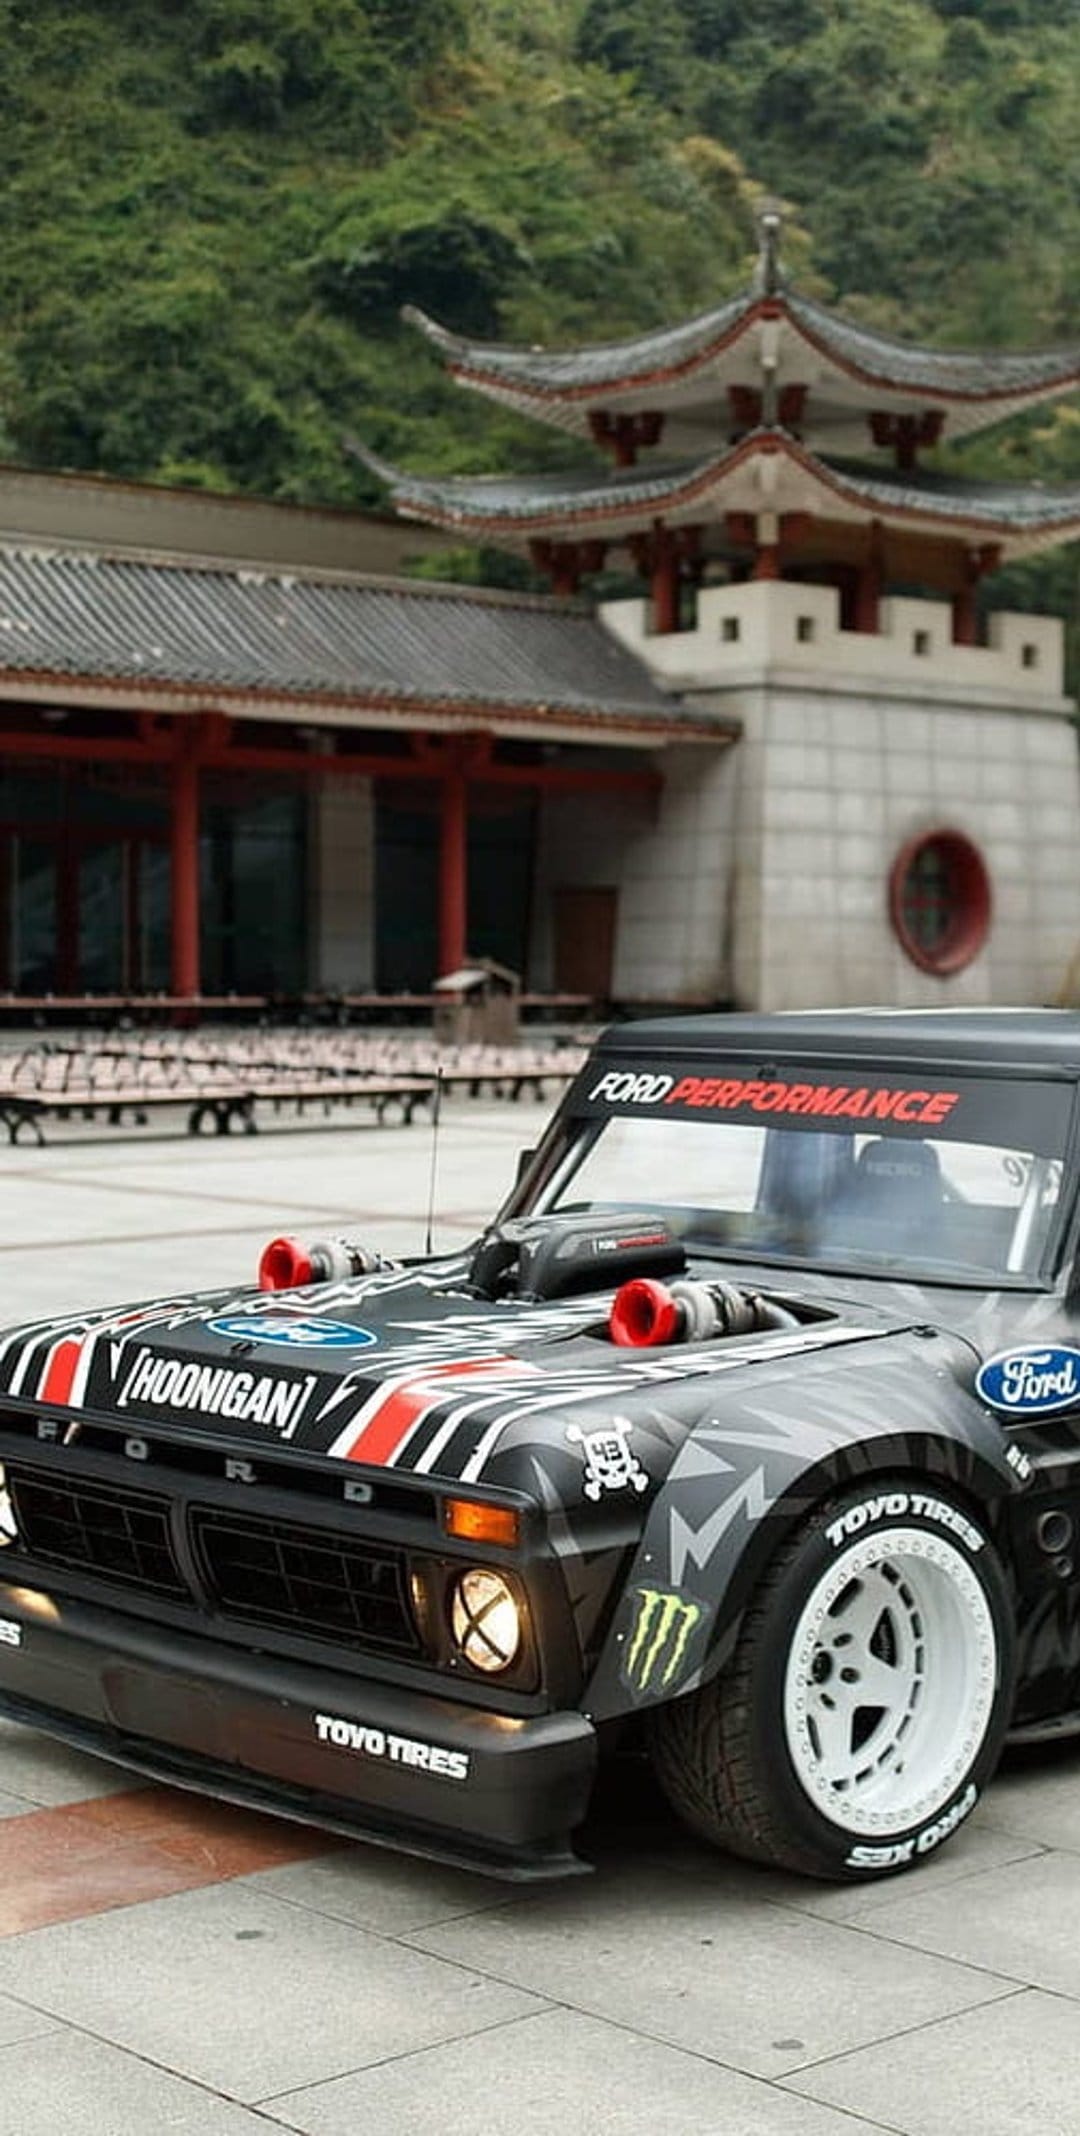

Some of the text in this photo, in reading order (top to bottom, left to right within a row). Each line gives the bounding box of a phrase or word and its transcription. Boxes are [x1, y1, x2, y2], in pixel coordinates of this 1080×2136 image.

[588, 1072, 959, 1124] FORD PERFORMANCE
[1002, 1353, 1077, 1402] Ford
[37, 1420, 374, 1502] FORD
[825, 1494, 985, 1552] TOYO TIRES
[315, 1714, 469, 1780] TOYO TIRES
